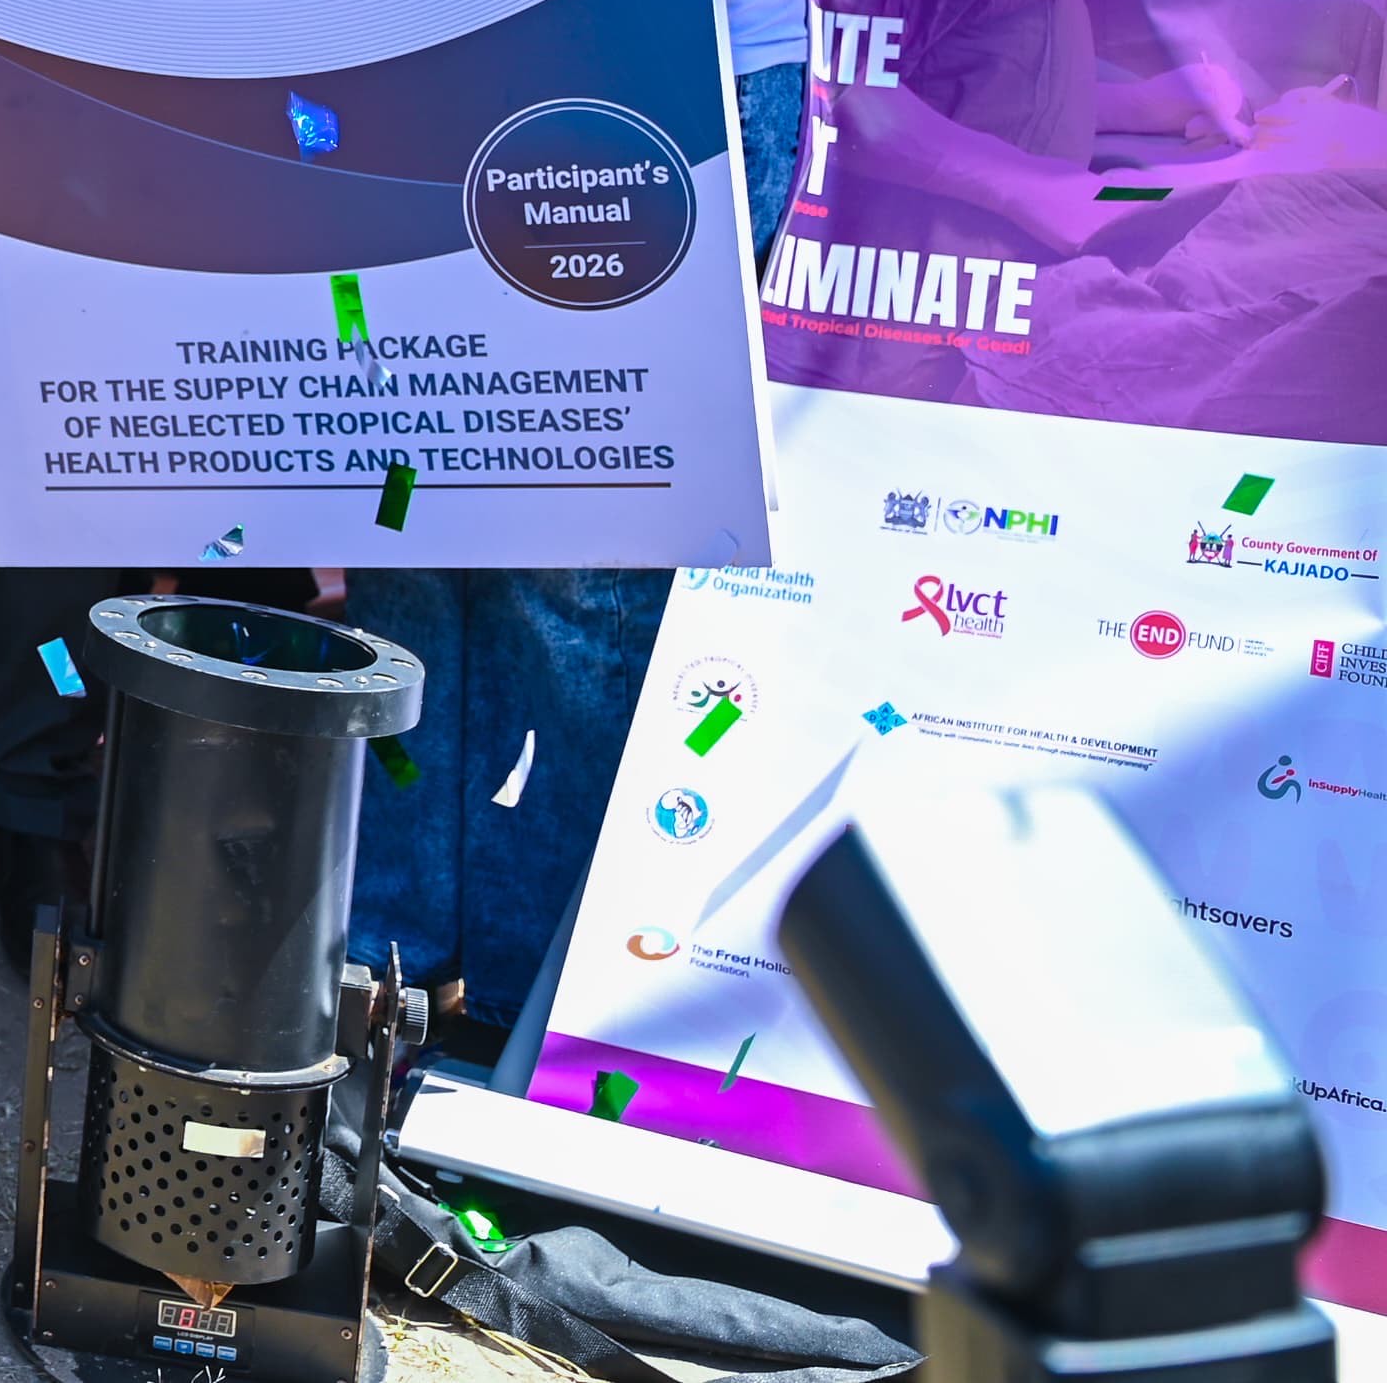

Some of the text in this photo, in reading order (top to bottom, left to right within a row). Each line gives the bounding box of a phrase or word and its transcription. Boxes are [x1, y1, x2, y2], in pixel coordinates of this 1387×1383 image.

[485, 159, 670, 195] Participant's
[523, 196, 631, 227] Manual
[549, 252, 624, 280] 2026
[791, 314, 860, 337] Tropical
[864, 323, 943, 346] Diseases
[946, 331, 972, 348] for
[176, 338, 328, 365] TRAINING
[40, 378, 98, 404] FOR
[107, 377, 167, 403] THE
[173, 375, 288, 401] SUPPLY
[409, 367, 649, 397] MANAGEMENT
[63, 405, 632, 439] OF NEGLECTED TROPICAL DISEASES'
[44, 442, 675, 474] HEALTH PRODUCTS AND TECHNOLOGIES
[983, 506, 1059, 536] NPHI
[1241, 536, 1378, 562] County Government Of
[765, 568, 814, 588] Health
[1264, 559, 1349, 581] KAJIADO
[713, 576, 812, 604] Organization
[946, 583, 1008, 618] lvct
[954, 613, 1004, 633] health
[1097, 619, 1127, 639] THE
[1138, 624, 1179, 646] END
[1188, 631, 1235, 652] FUND
[1314, 642, 1329, 673] CIFF
[1340, 656, 1387, 674] INVES
[1339, 669, 1387, 688] FOUN
[911, 712, 954, 727] AFRICAN
[956, 719, 1005, 734] INSTITUTE
[1007, 726, 1027, 737] FOR
[1029, 730, 1068, 743] HEALTH
[1080, 737, 1158, 758] DEVELOPMENT
[1308, 778, 1387, 801] InSupplyHealt
[690, 957, 749, 978] Foundation
[692, 944, 792, 975] The Fred Hollo
